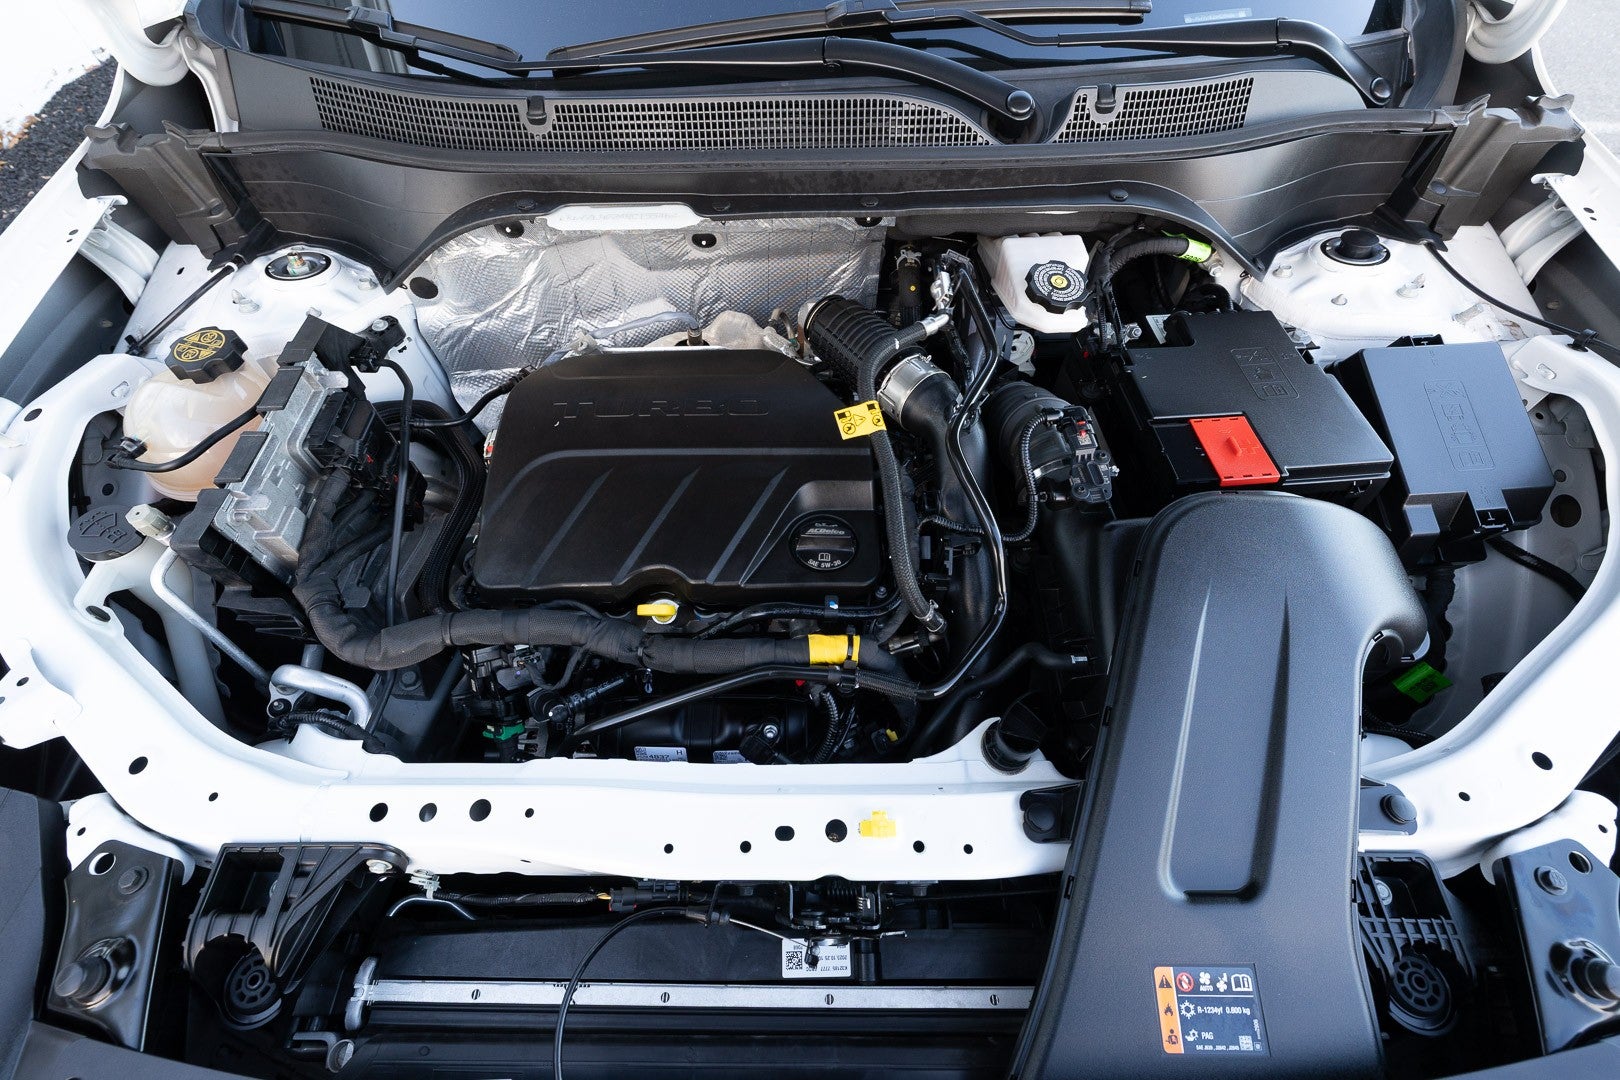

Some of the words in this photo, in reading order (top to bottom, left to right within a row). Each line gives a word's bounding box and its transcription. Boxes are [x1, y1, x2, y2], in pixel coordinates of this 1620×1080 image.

[553, 400, 769, 419] TURBO
[807, 559, 819, 567] SAE
[1197, 1006, 1223, 1016] R-1234yf
[1242, 1006, 1251, 1016] kg
[1201, 1032, 1214, 1040] PAG
